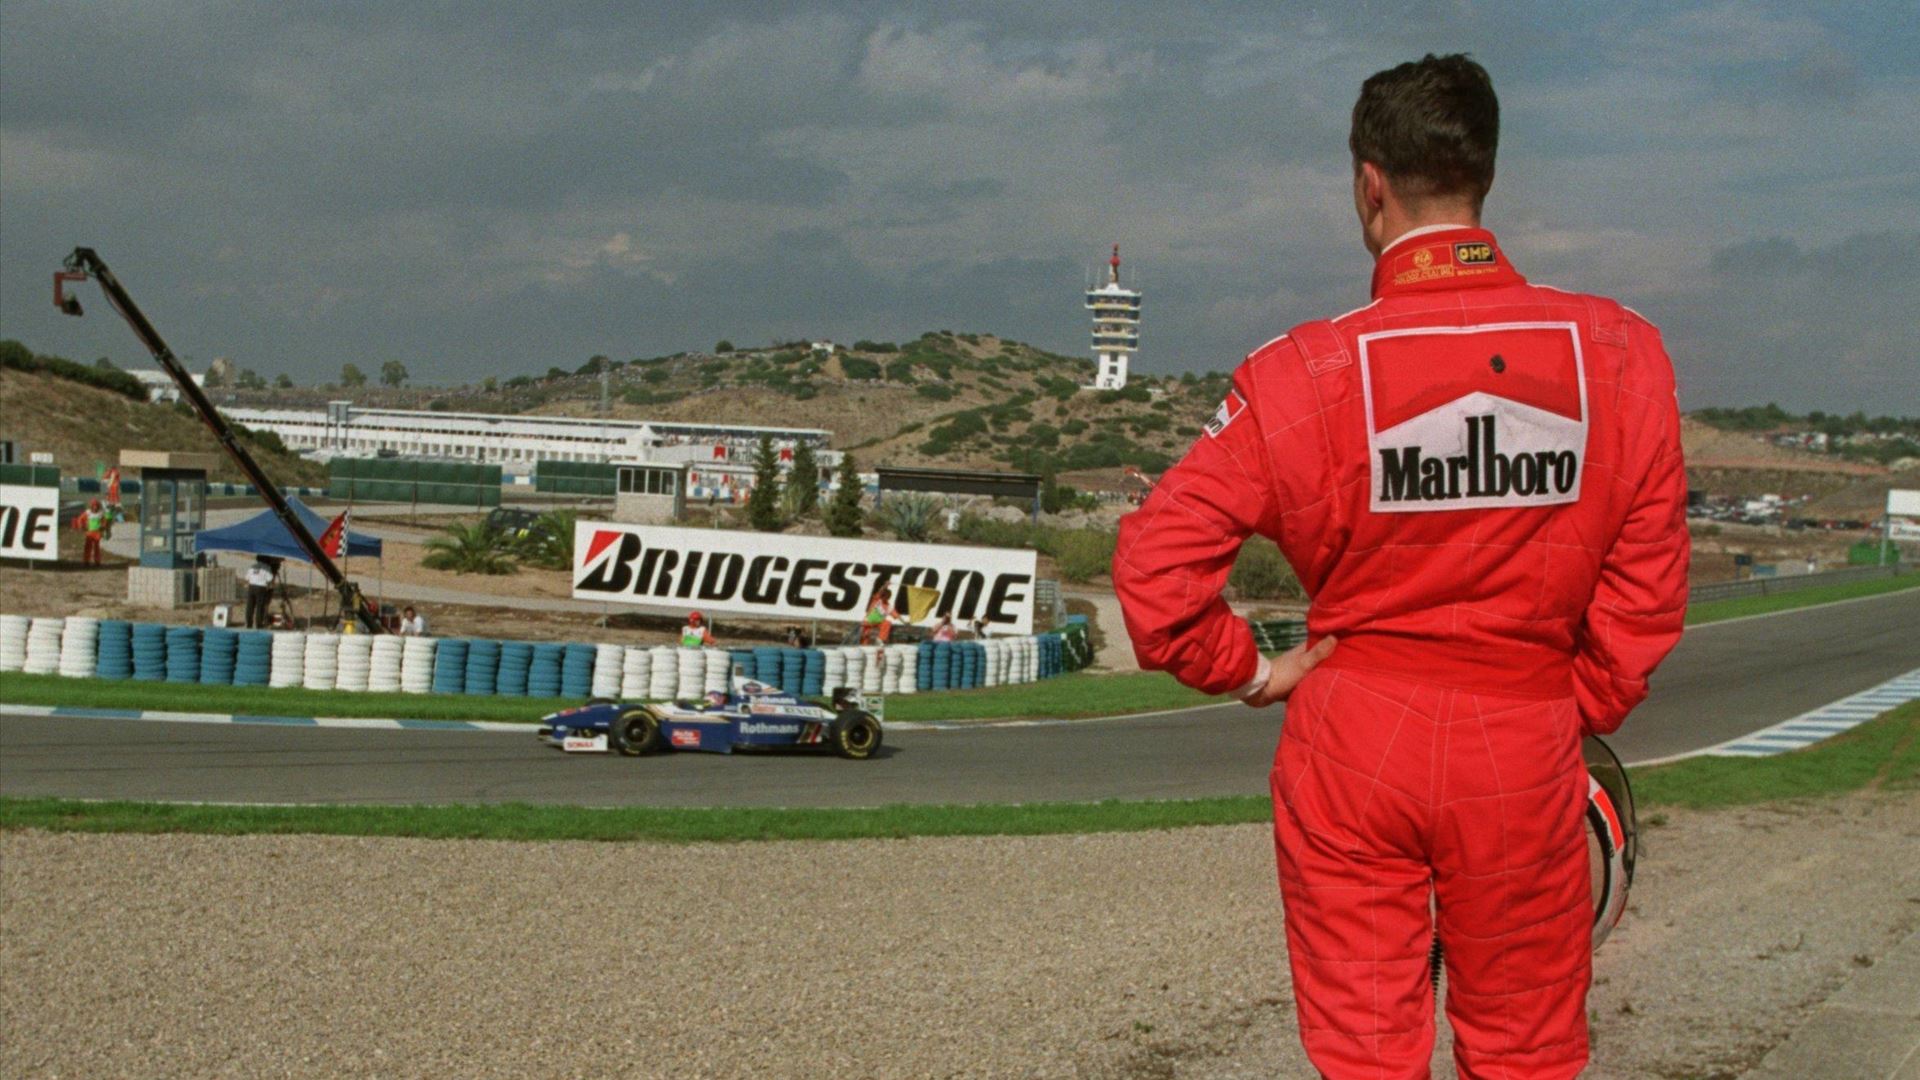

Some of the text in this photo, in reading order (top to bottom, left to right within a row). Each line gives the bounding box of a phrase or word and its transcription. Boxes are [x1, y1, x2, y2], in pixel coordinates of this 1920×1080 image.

[1459, 246, 1491, 260] OMP
[1379, 415, 1577, 501] Marlboro
[575, 530, 1031, 624] BRIDGESTONE
[740, 722, 800, 734] Rothmans
